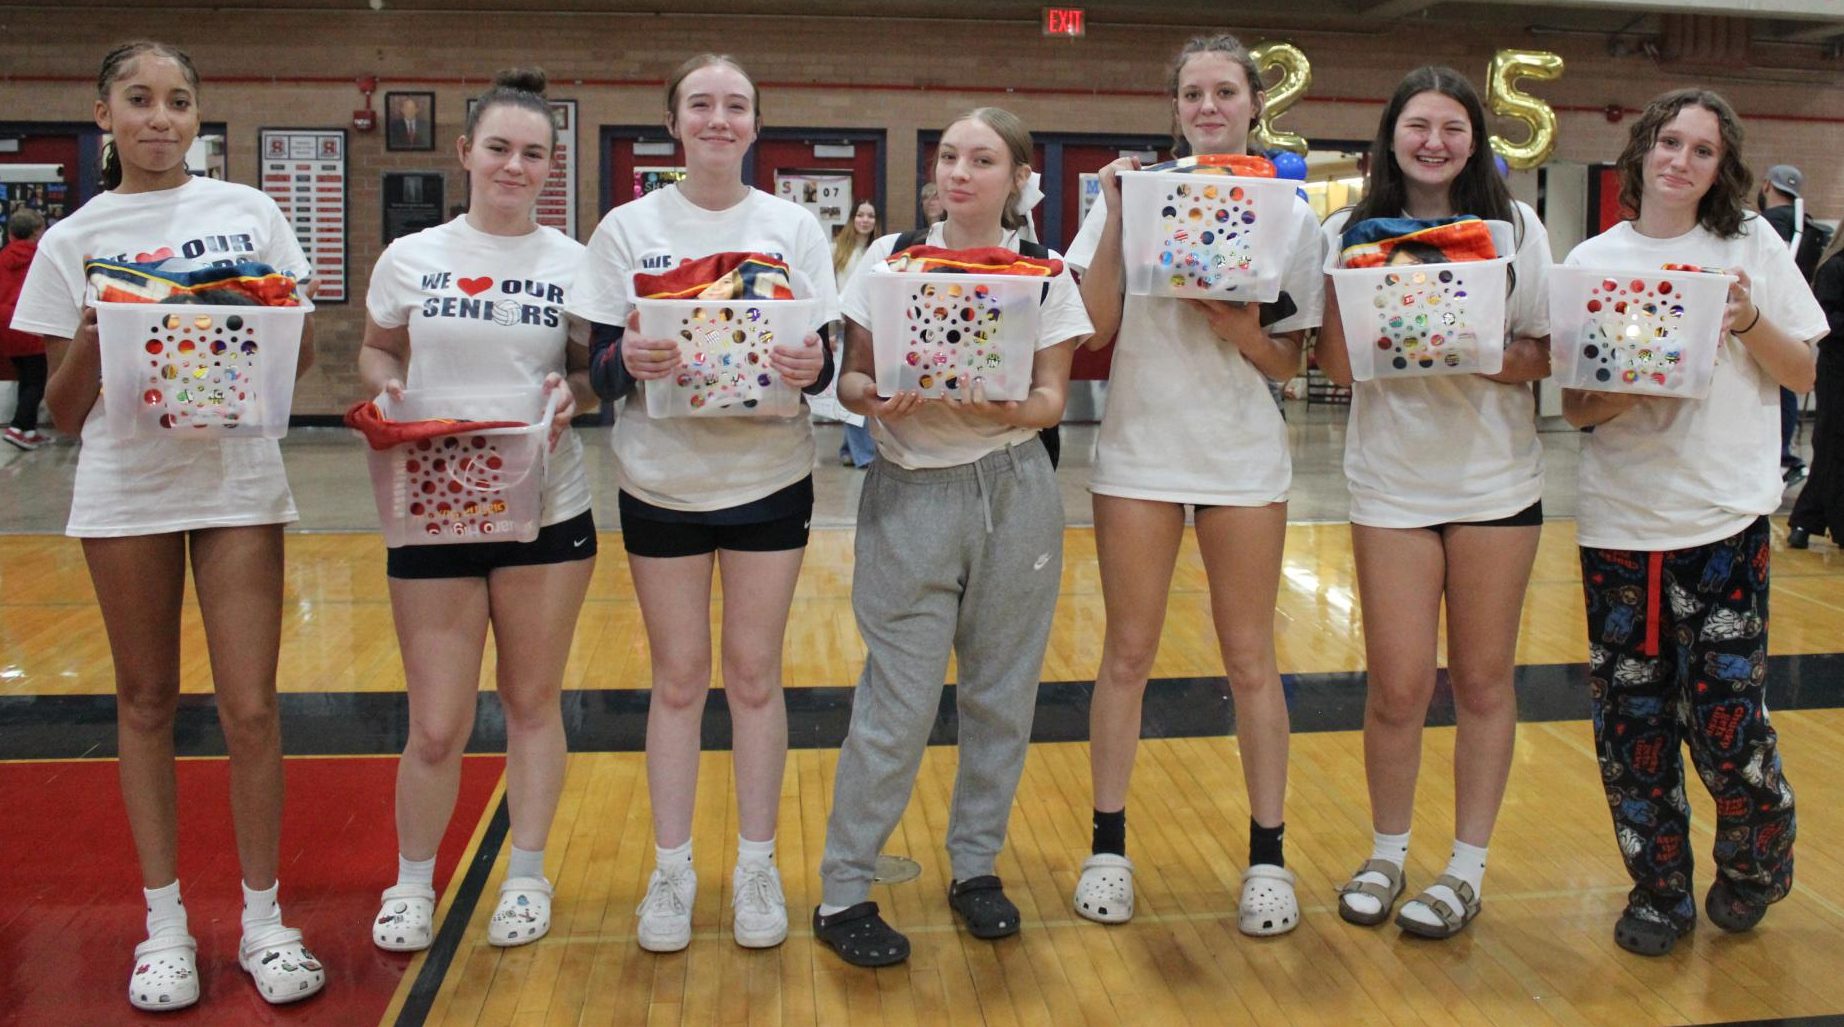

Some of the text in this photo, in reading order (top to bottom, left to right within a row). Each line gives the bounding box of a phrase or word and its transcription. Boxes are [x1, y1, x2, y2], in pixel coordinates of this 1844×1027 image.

[1048, 9, 1083, 33] EXIT
[1249, 43, 1566, 170] 2 5
[181, 233, 254, 259] OUR
[421, 271, 565, 305] WE OUR
